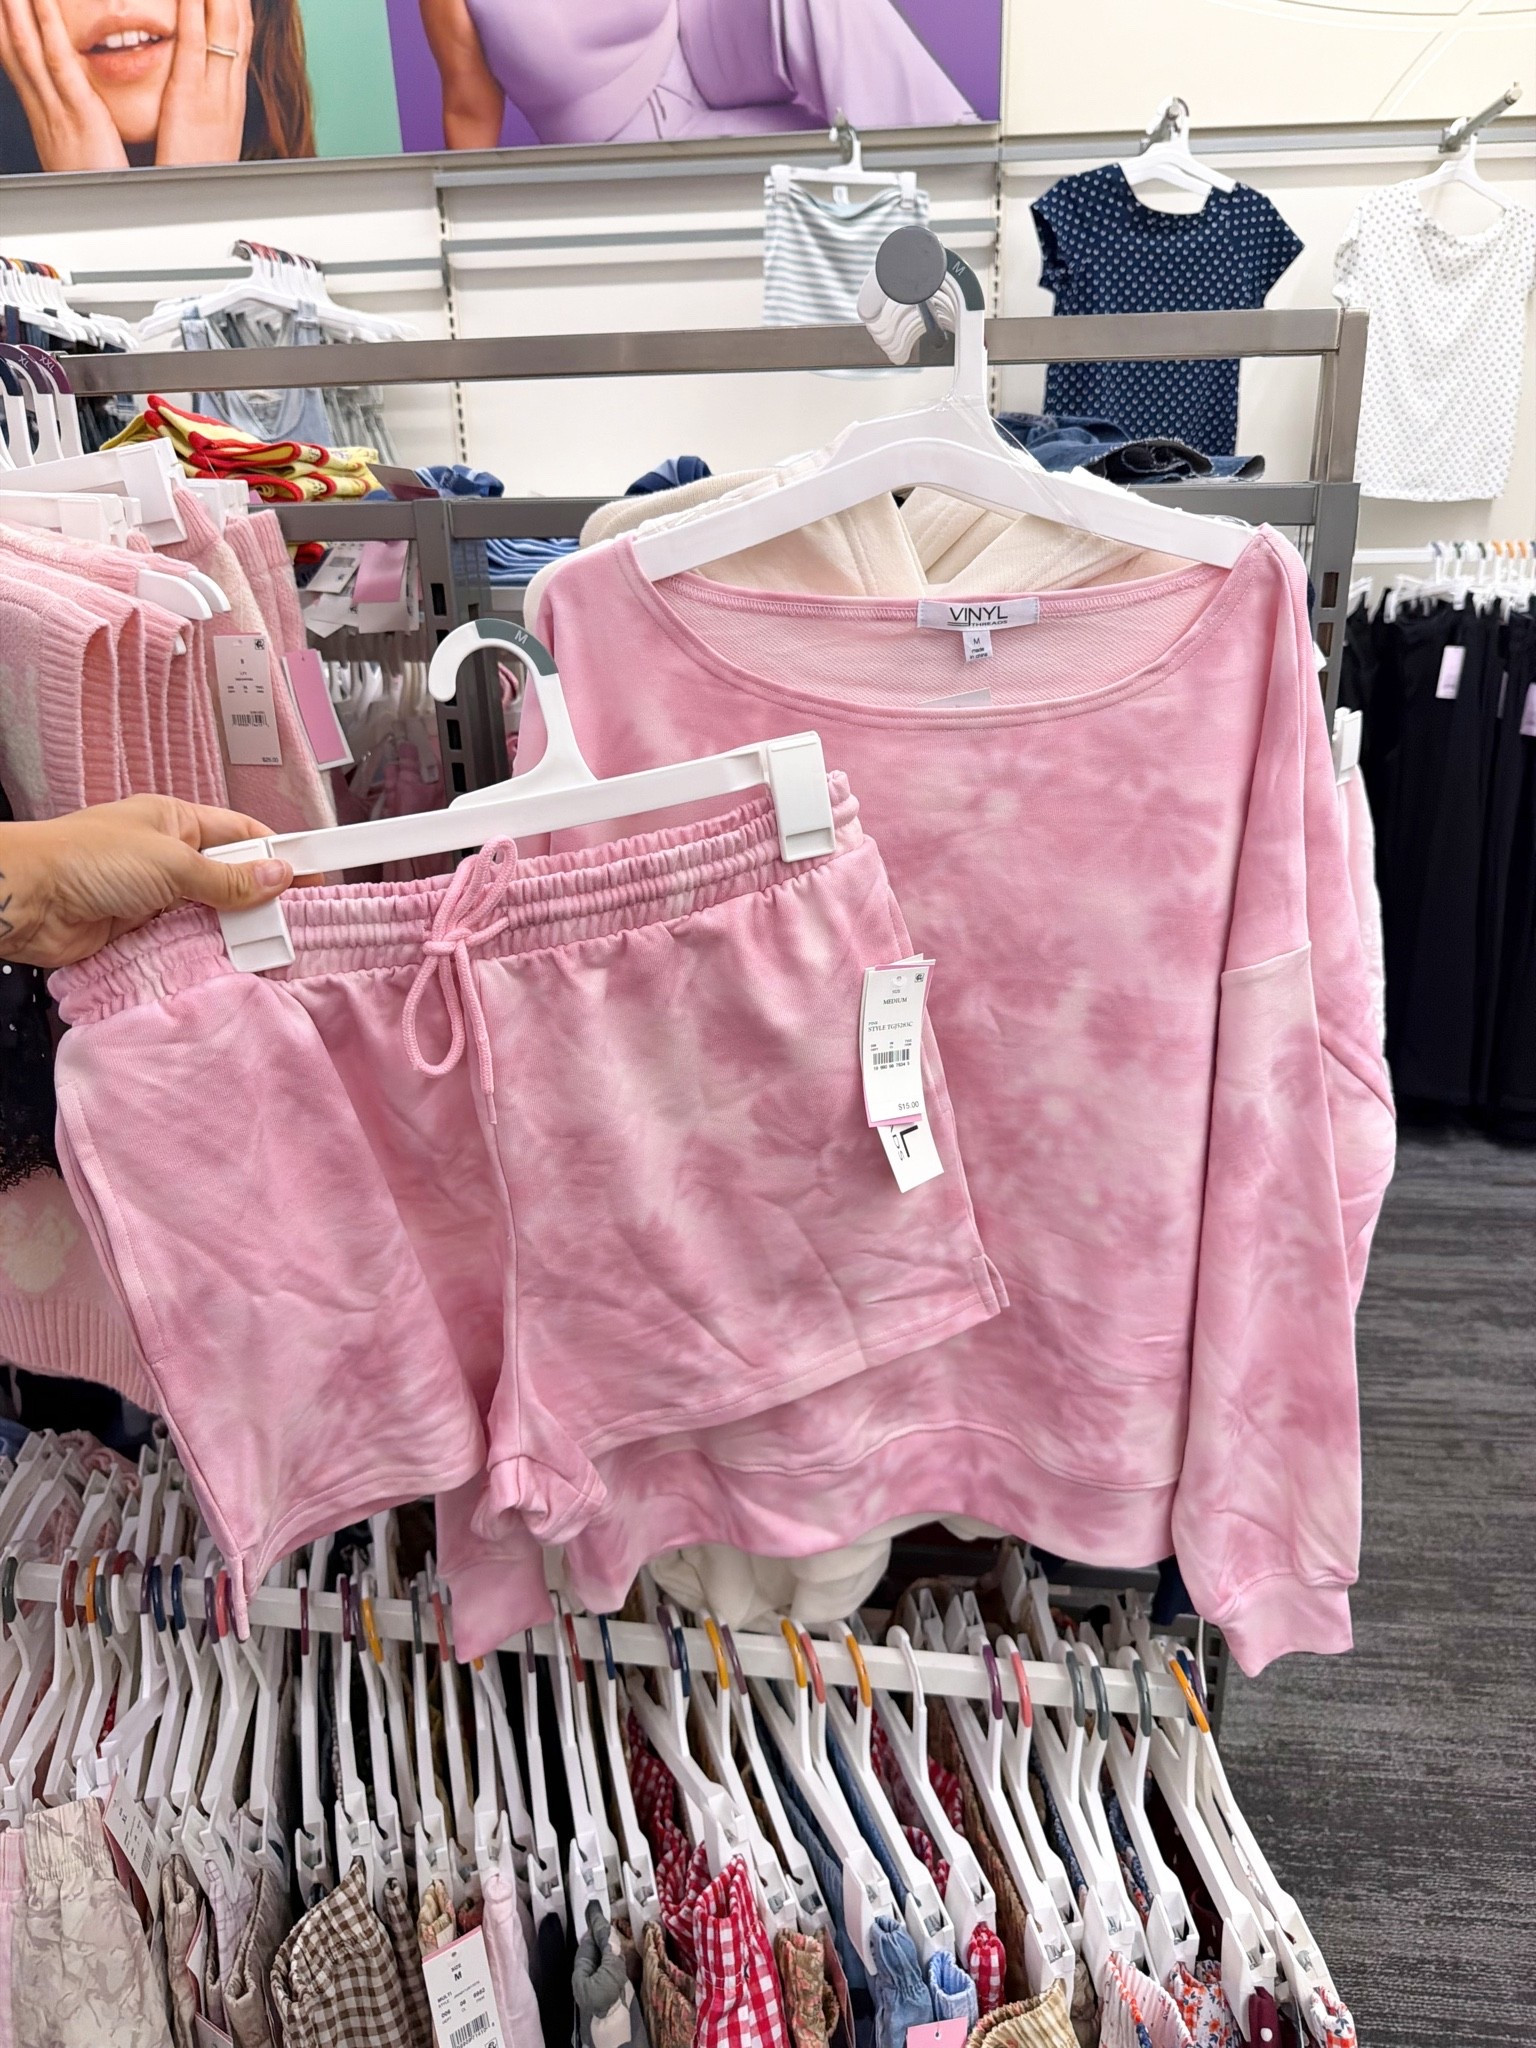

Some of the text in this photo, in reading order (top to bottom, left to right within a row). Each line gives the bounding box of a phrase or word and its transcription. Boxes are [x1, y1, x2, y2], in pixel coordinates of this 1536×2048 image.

[952, 261, 966, 276] M
[18, 355, 30, 370] XL
[40, 354, 55, 373] XXL
[949, 606, 1008, 626] VINYL
[514, 629, 528, 645] M
[883, 997, 908, 1005] MEDIUM
[868, 1024, 886, 1032] STYLE
[898, 1101, 920, 1111] $15.00
[454, 1971, 463, 1981] M
[437, 1991, 452, 2003] MULTI
